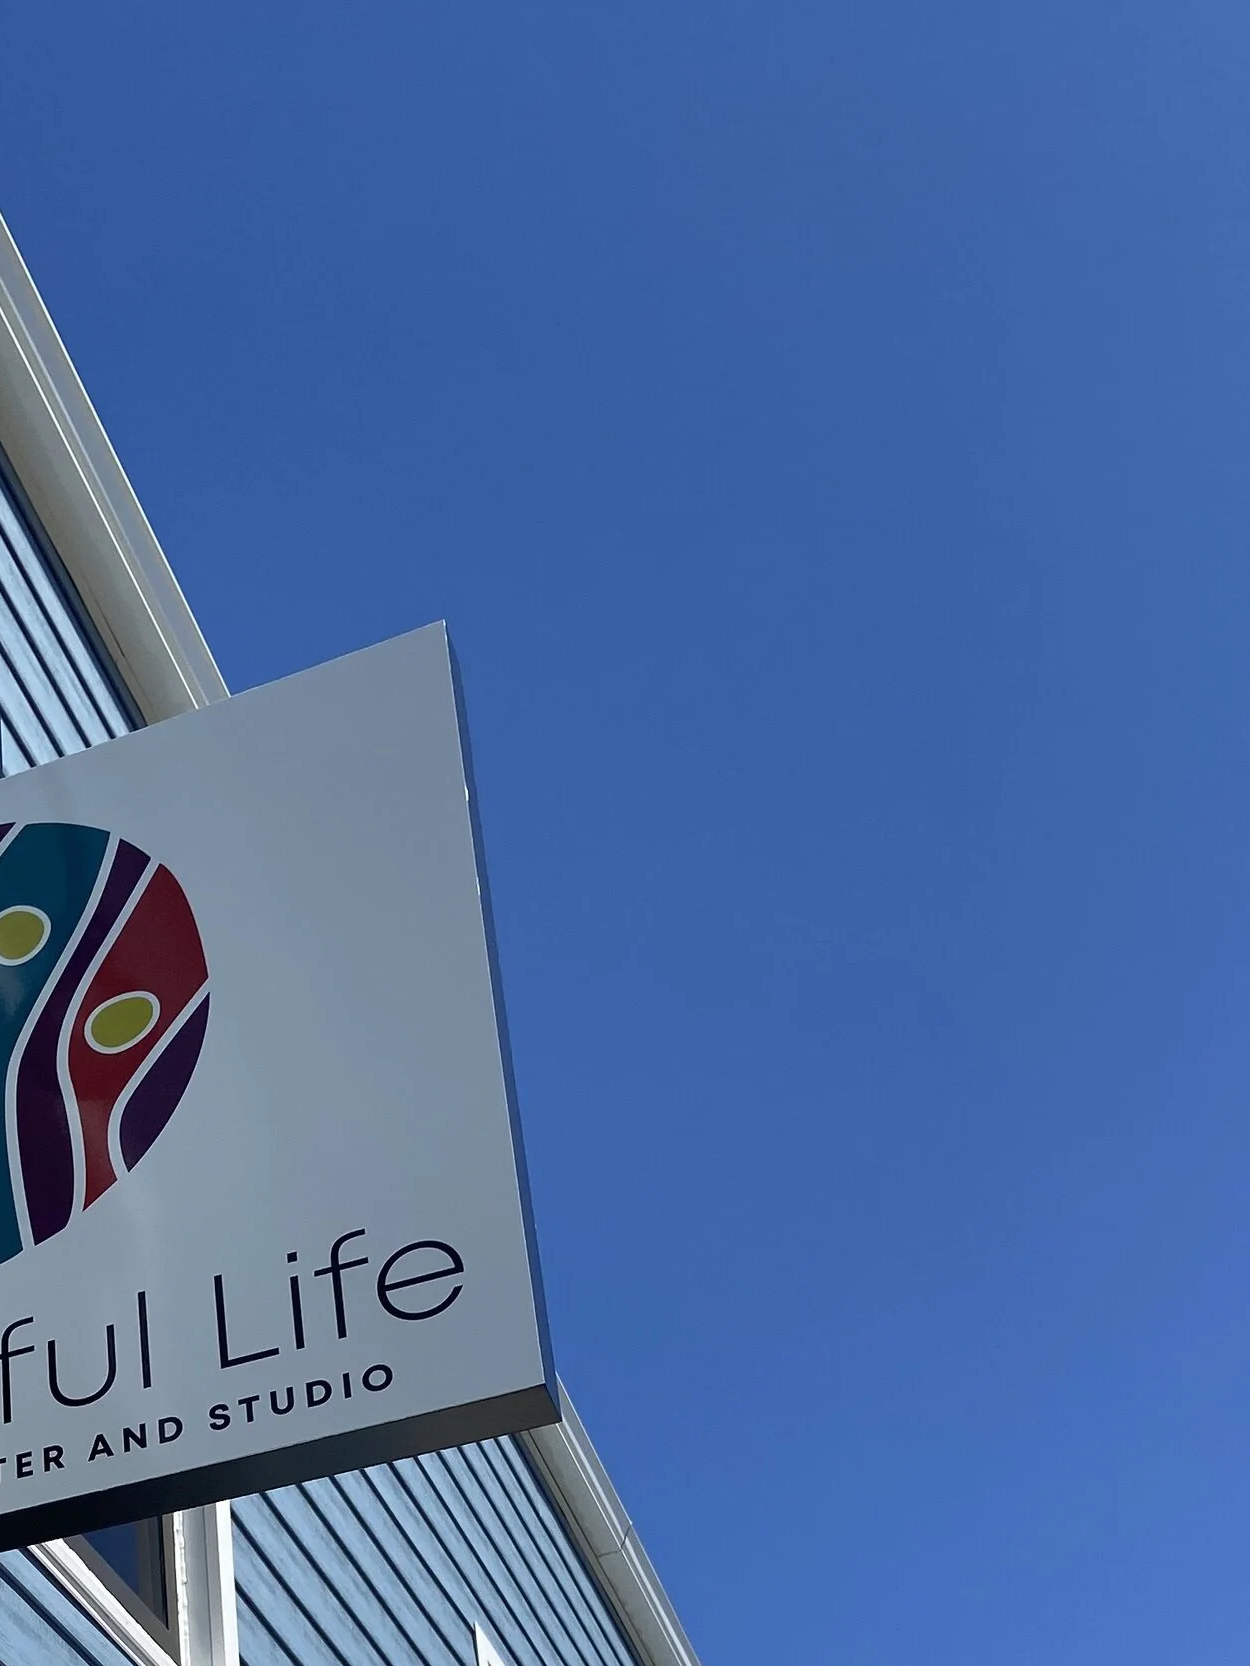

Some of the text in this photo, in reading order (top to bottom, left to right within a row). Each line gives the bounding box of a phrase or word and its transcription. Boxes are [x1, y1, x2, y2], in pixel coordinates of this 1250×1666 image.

[212, 1227, 466, 1371] Life
[86, 1415, 184, 1463] AND
[207, 1363, 394, 1432] STUDIO
